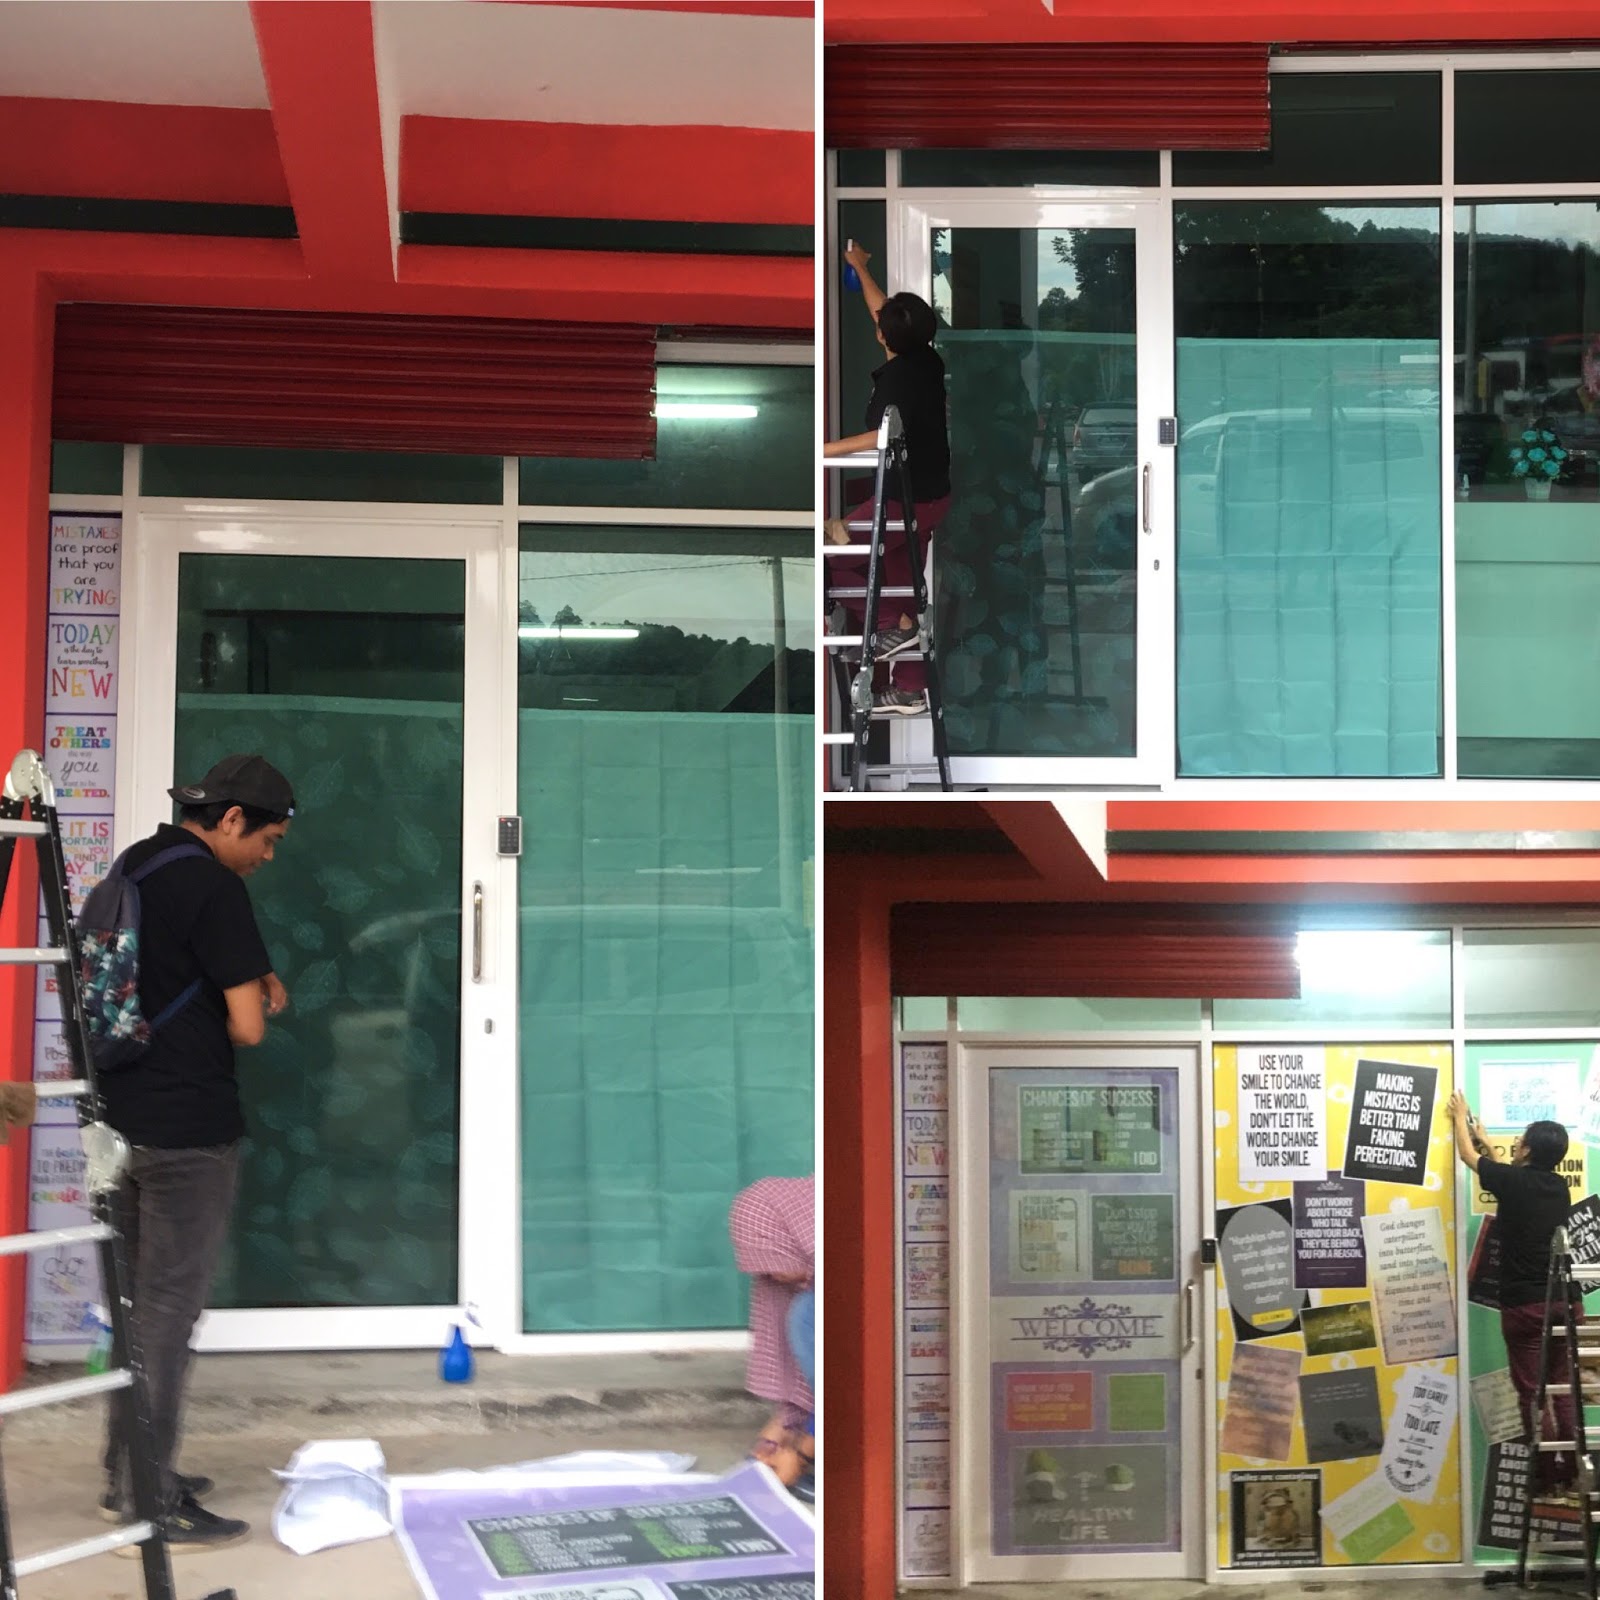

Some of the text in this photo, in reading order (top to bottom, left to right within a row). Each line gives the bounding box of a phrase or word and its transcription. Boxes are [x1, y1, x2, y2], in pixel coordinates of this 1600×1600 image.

[53, 526, 119, 540] MISTAKES
[54, 542, 119, 556] are proof
[58, 557, 115, 573] that you
[73, 576, 97, 586] are
[53, 588, 117, 605] TRYING
[51, 623, 116, 645] TODAY
[51, 666, 113, 699] NEW
[55, 726, 107, 738] TREAT
[50, 738, 111, 749] OTHERS
[61, 759, 99, 781] you
[54, 788, 110, 799] REATED.
[69, 822, 86, 836] IT
[93, 822, 109, 837] IS
[60, 837, 109, 846] PORTANT
[65, 862, 108, 875] AY. IF
[1259, 1055, 1303, 1070] USE YOUR
[1241, 1074, 1321, 1090] SMILE TO CHANGE
[1376, 1073, 1414, 1092] MAKING
[1023, 1090, 1080, 1106] CHANCES
[1254, 1094, 1308, 1111] THE WORLD,
[1363, 1090, 1421, 1112] MISTAKES IS
[1250, 1113, 1314, 1128] DON'T LET THE
[1359, 1110, 1420, 1131] BETTER THAN
[1246, 1132, 1318, 1147] WORLD CHANGE
[1370, 1128, 1405, 1147] FAKING
[1254, 1151, 1310, 1167] YOUR SMILE.
[1354, 1145, 1417, 1168] PERFECTIONS.
[1327, 1197, 1353, 1207] WORRY
[1307, 1208, 1353, 1217] ABOUT THOSE
[1568, 1206, 1593, 1232] LOW
[1311, 1219, 1347, 1228] WHO TALK
[1380, 1219, 1426, 1232] God changes
[1295, 1229, 1321, 1238] BEHIND
[1322, 1229, 1342, 1238] YOUR
[1302, 1239, 1358, 1249] THEY'RE BEHIND
[1297, 1249, 1312, 1259] YOU
[1313, 1249, 1326, 1258] FOR
[1018, 1318, 1157, 1337] WELCOME
[1500, 1442, 1530, 1458] EVER
[1495, 1485, 1511, 1498] TO
[475, 1512, 590, 1532] CHANCES
[1033, 1507, 1136, 1522] HEALTHY
[1059, 1525, 1110, 1541] LIFE
